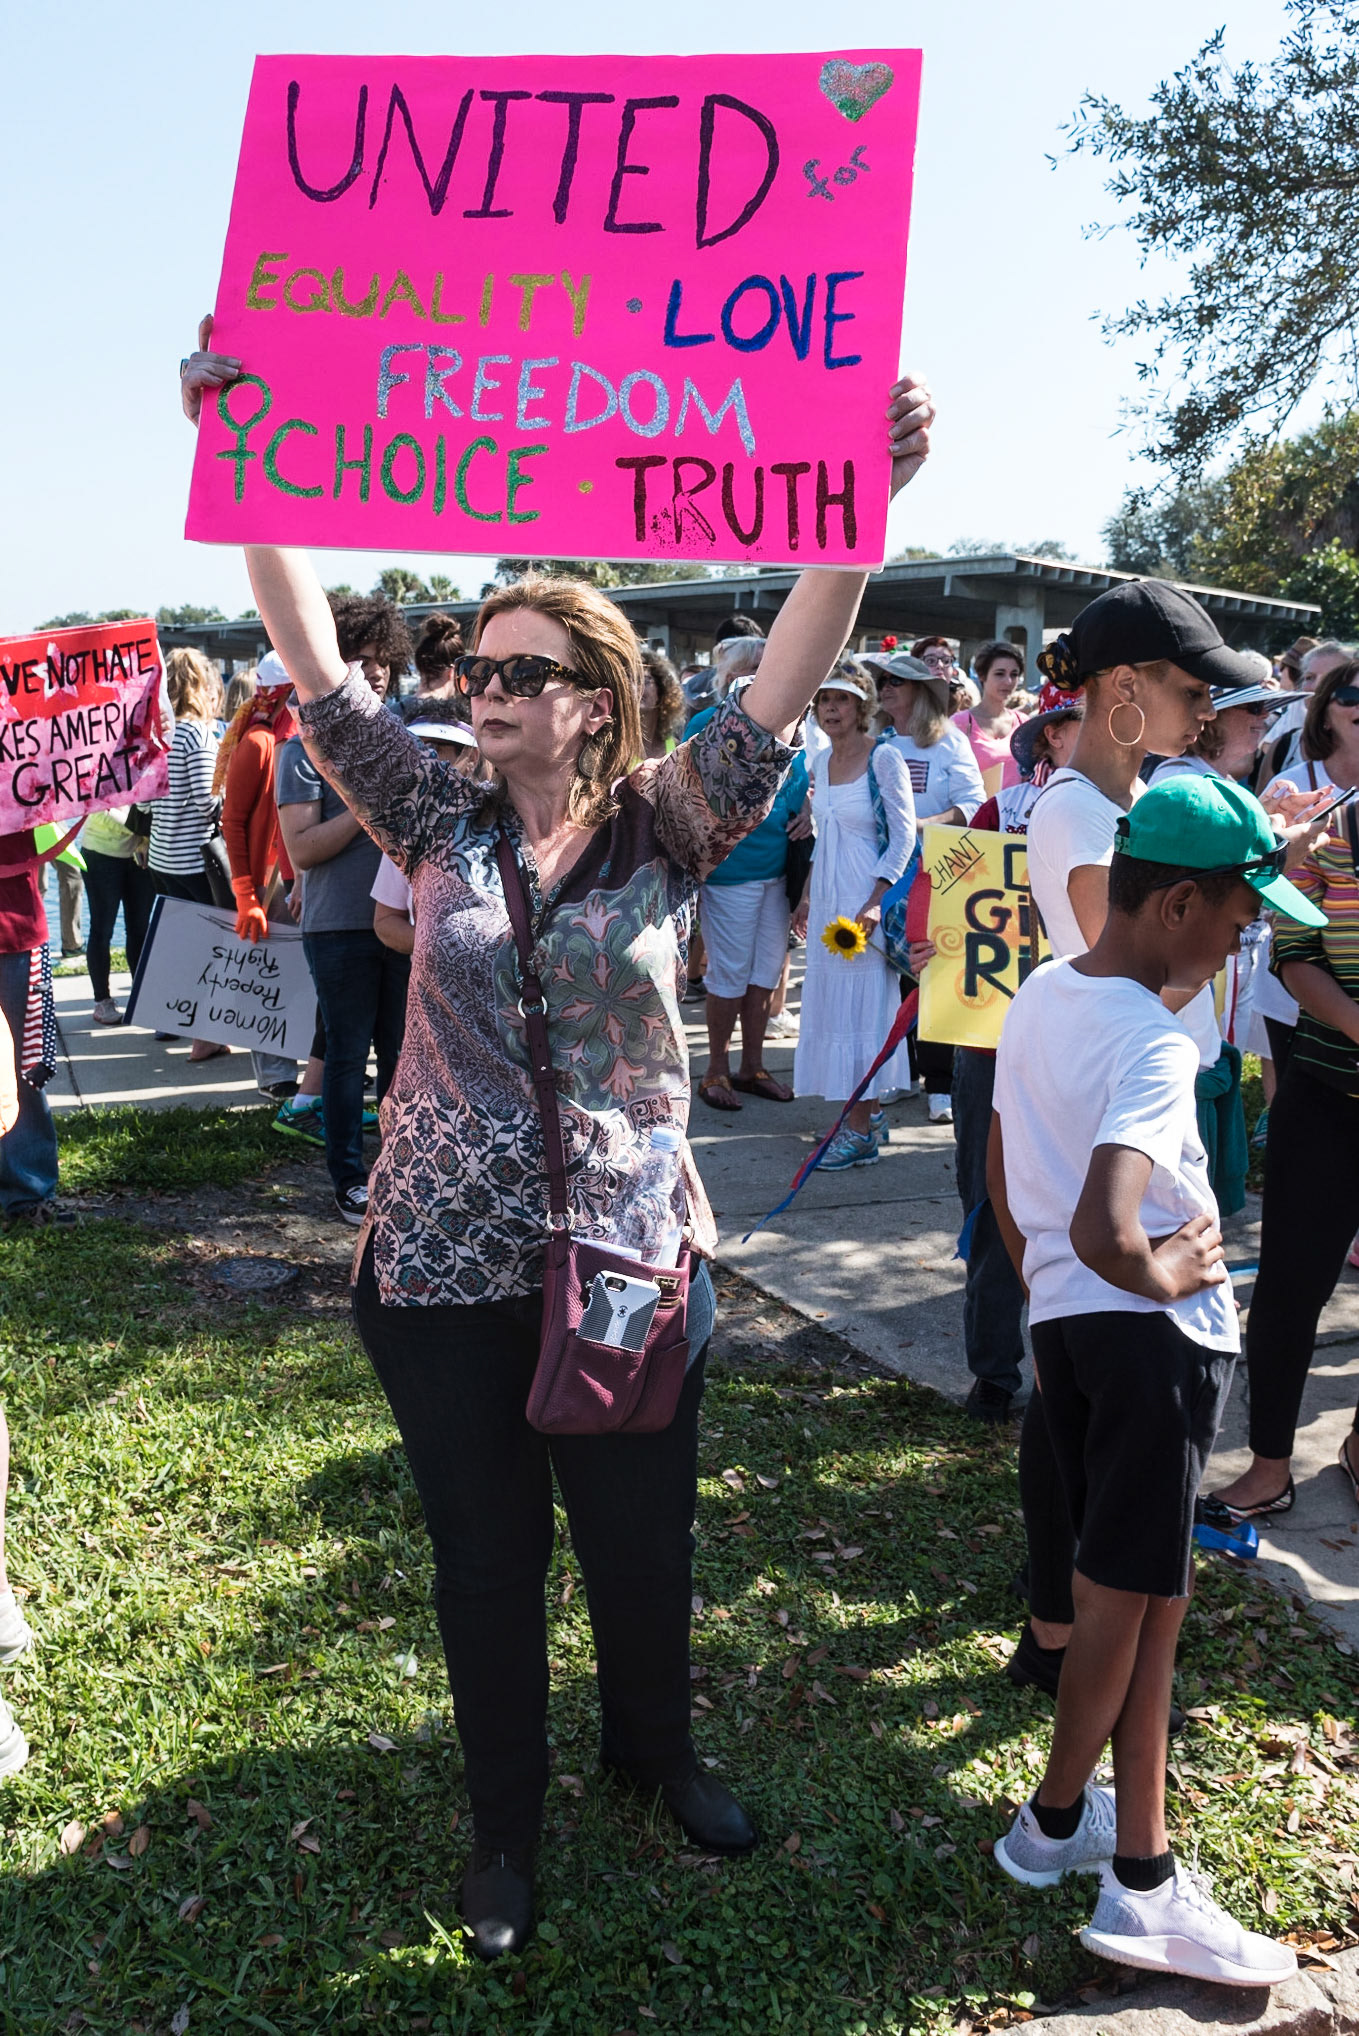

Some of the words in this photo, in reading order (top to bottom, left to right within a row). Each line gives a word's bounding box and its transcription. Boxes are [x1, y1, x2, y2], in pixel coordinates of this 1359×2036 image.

[287, 80, 780, 249] UNITED
[803, 145, 871, 201] for
[246, 252, 593, 337] EQUALITY
[664, 271, 865, 369] LOVE
[375, 344, 756, 457] FREEDOM
[263, 418, 549, 525] CHOICE
[616, 456, 857, 551] TRUTH
[47, 651, 91, 690] NOT
[92, 638, 155, 684] HATE
[12, 746, 140, 806] GREAT
[928, 831, 980, 889] CHANT
[198, 962, 286, 1011] Property
[212, 945, 281, 979] Rights
[209, 1006, 286, 1049] Women
